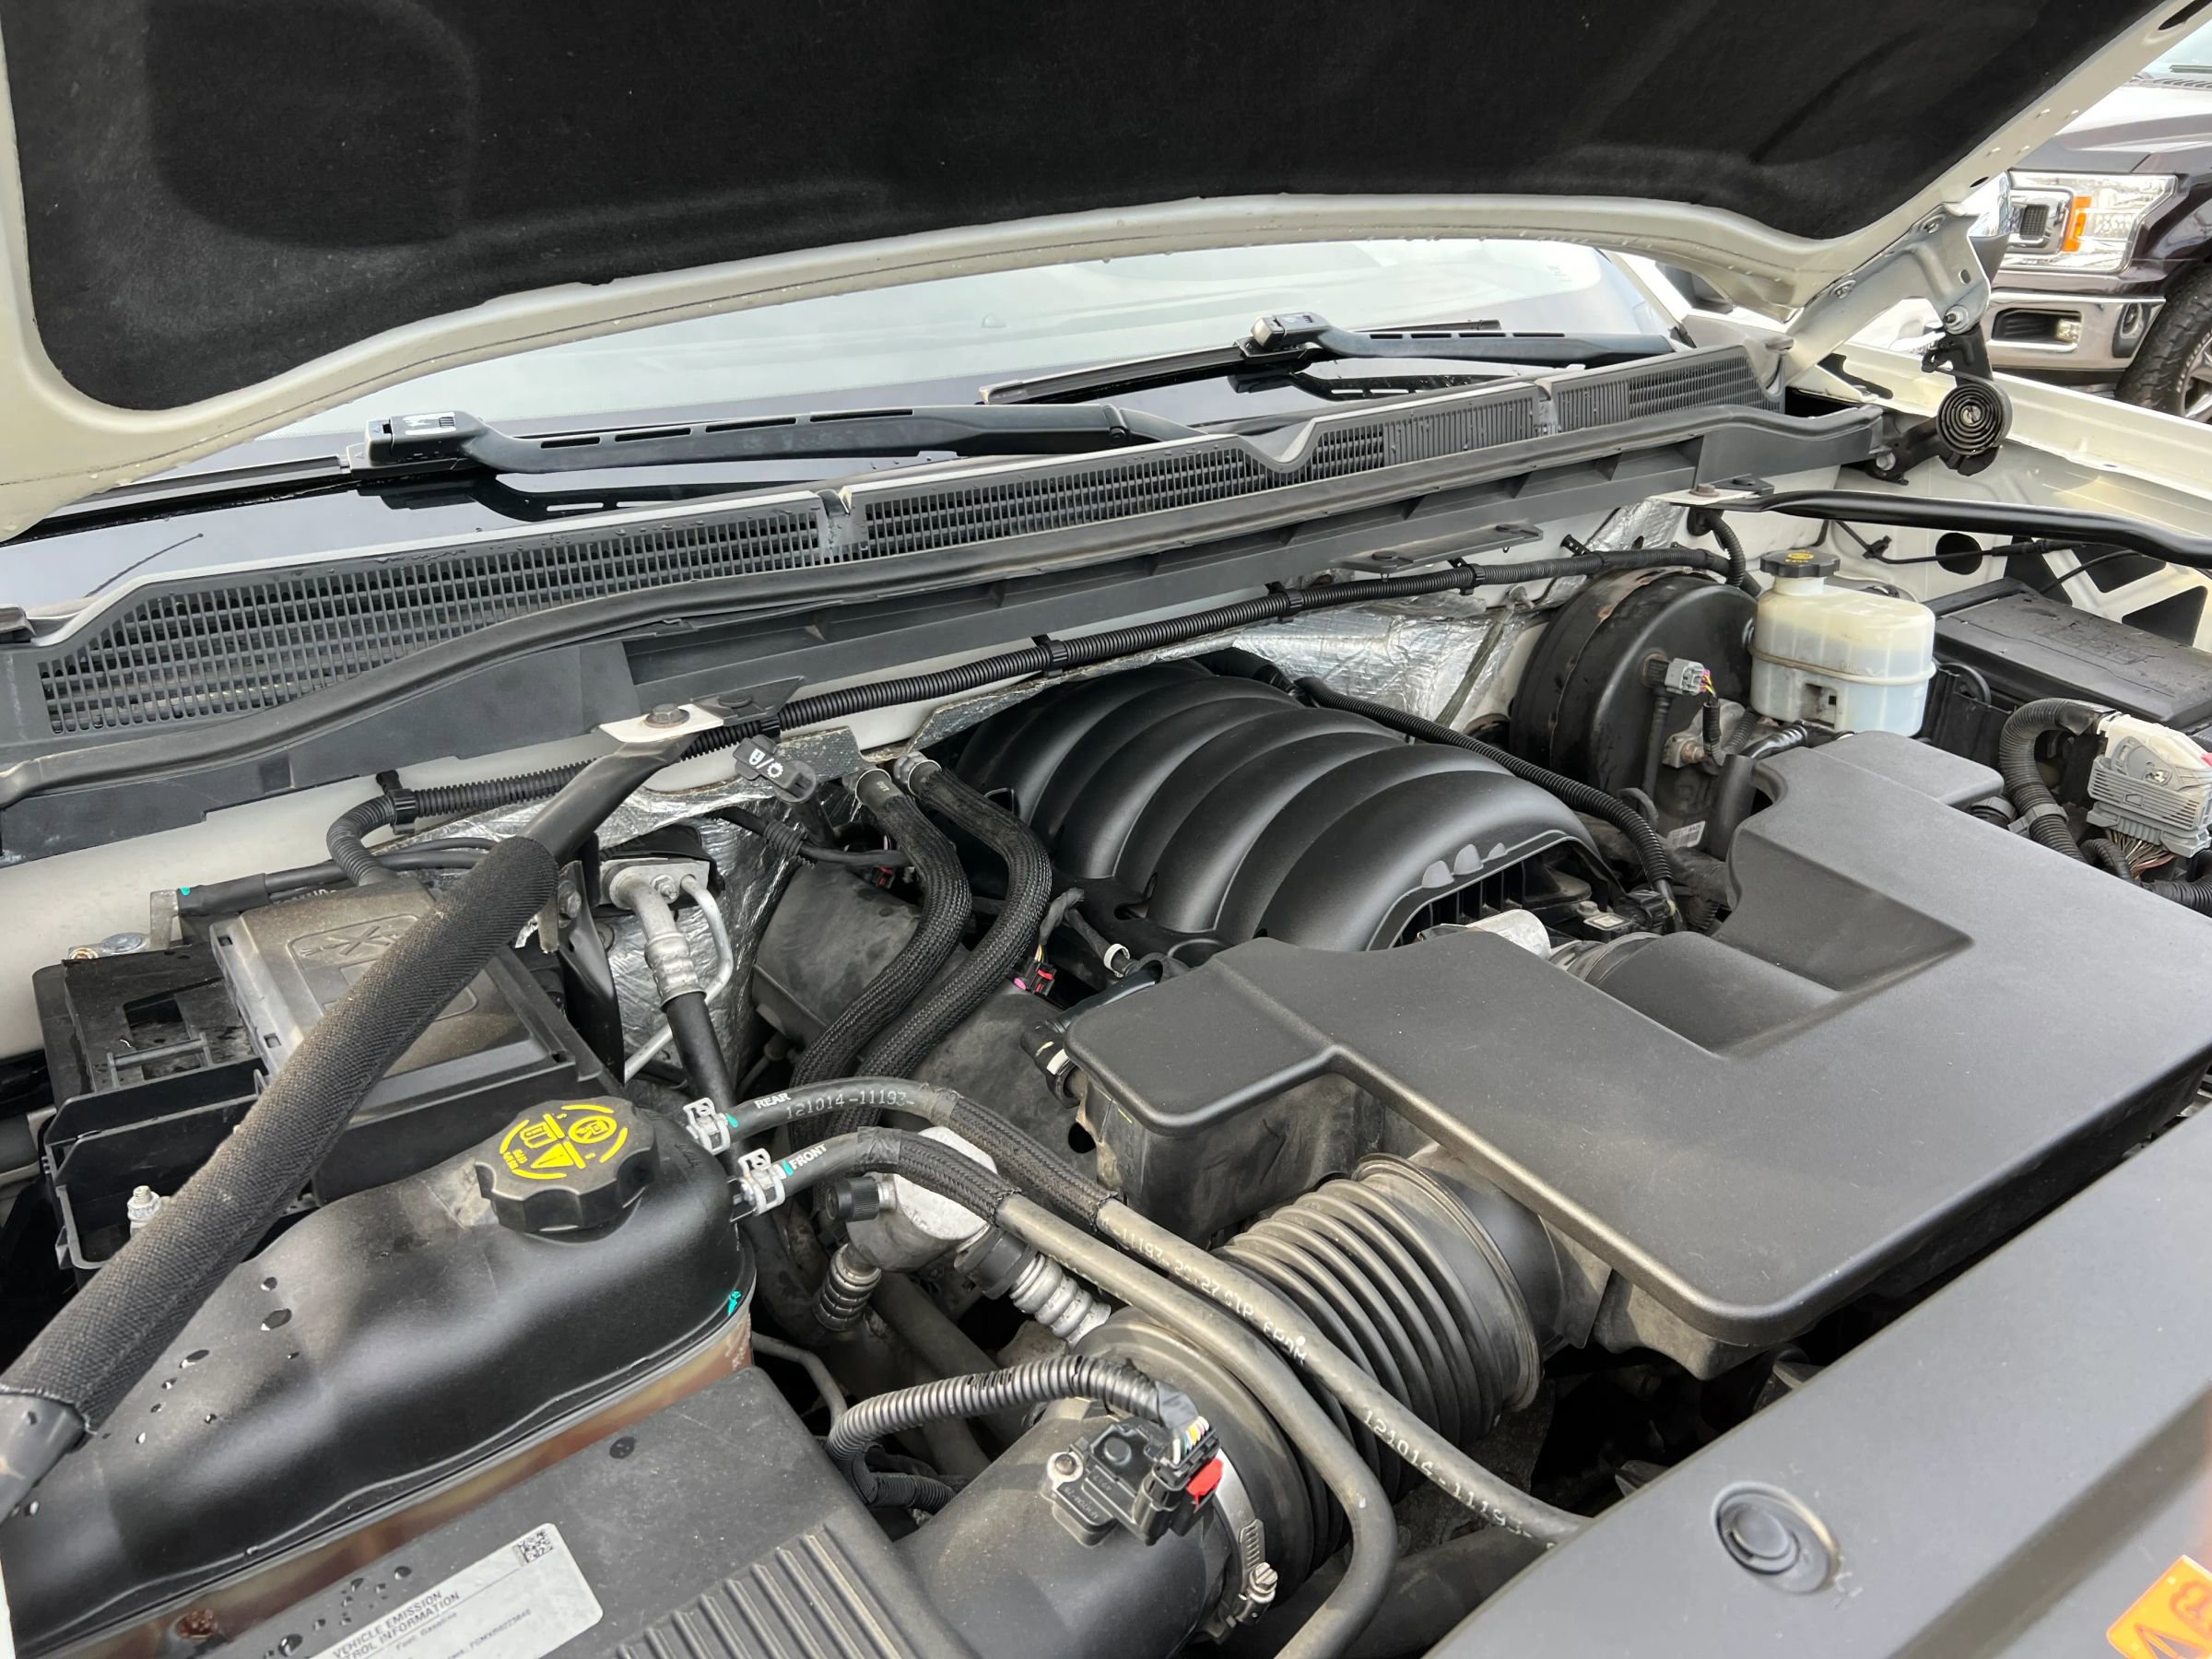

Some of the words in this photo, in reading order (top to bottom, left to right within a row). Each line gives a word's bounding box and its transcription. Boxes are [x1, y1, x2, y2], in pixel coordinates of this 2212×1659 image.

[754, 1091, 793, 1110] REAR
[791, 1144, 828, 1171] FRONT
[333, 1627, 384, 1659] VEHICLE
[385, 1592, 442, 1629] EMISSION
[379, 1592, 461, 1644] INFORMATION
